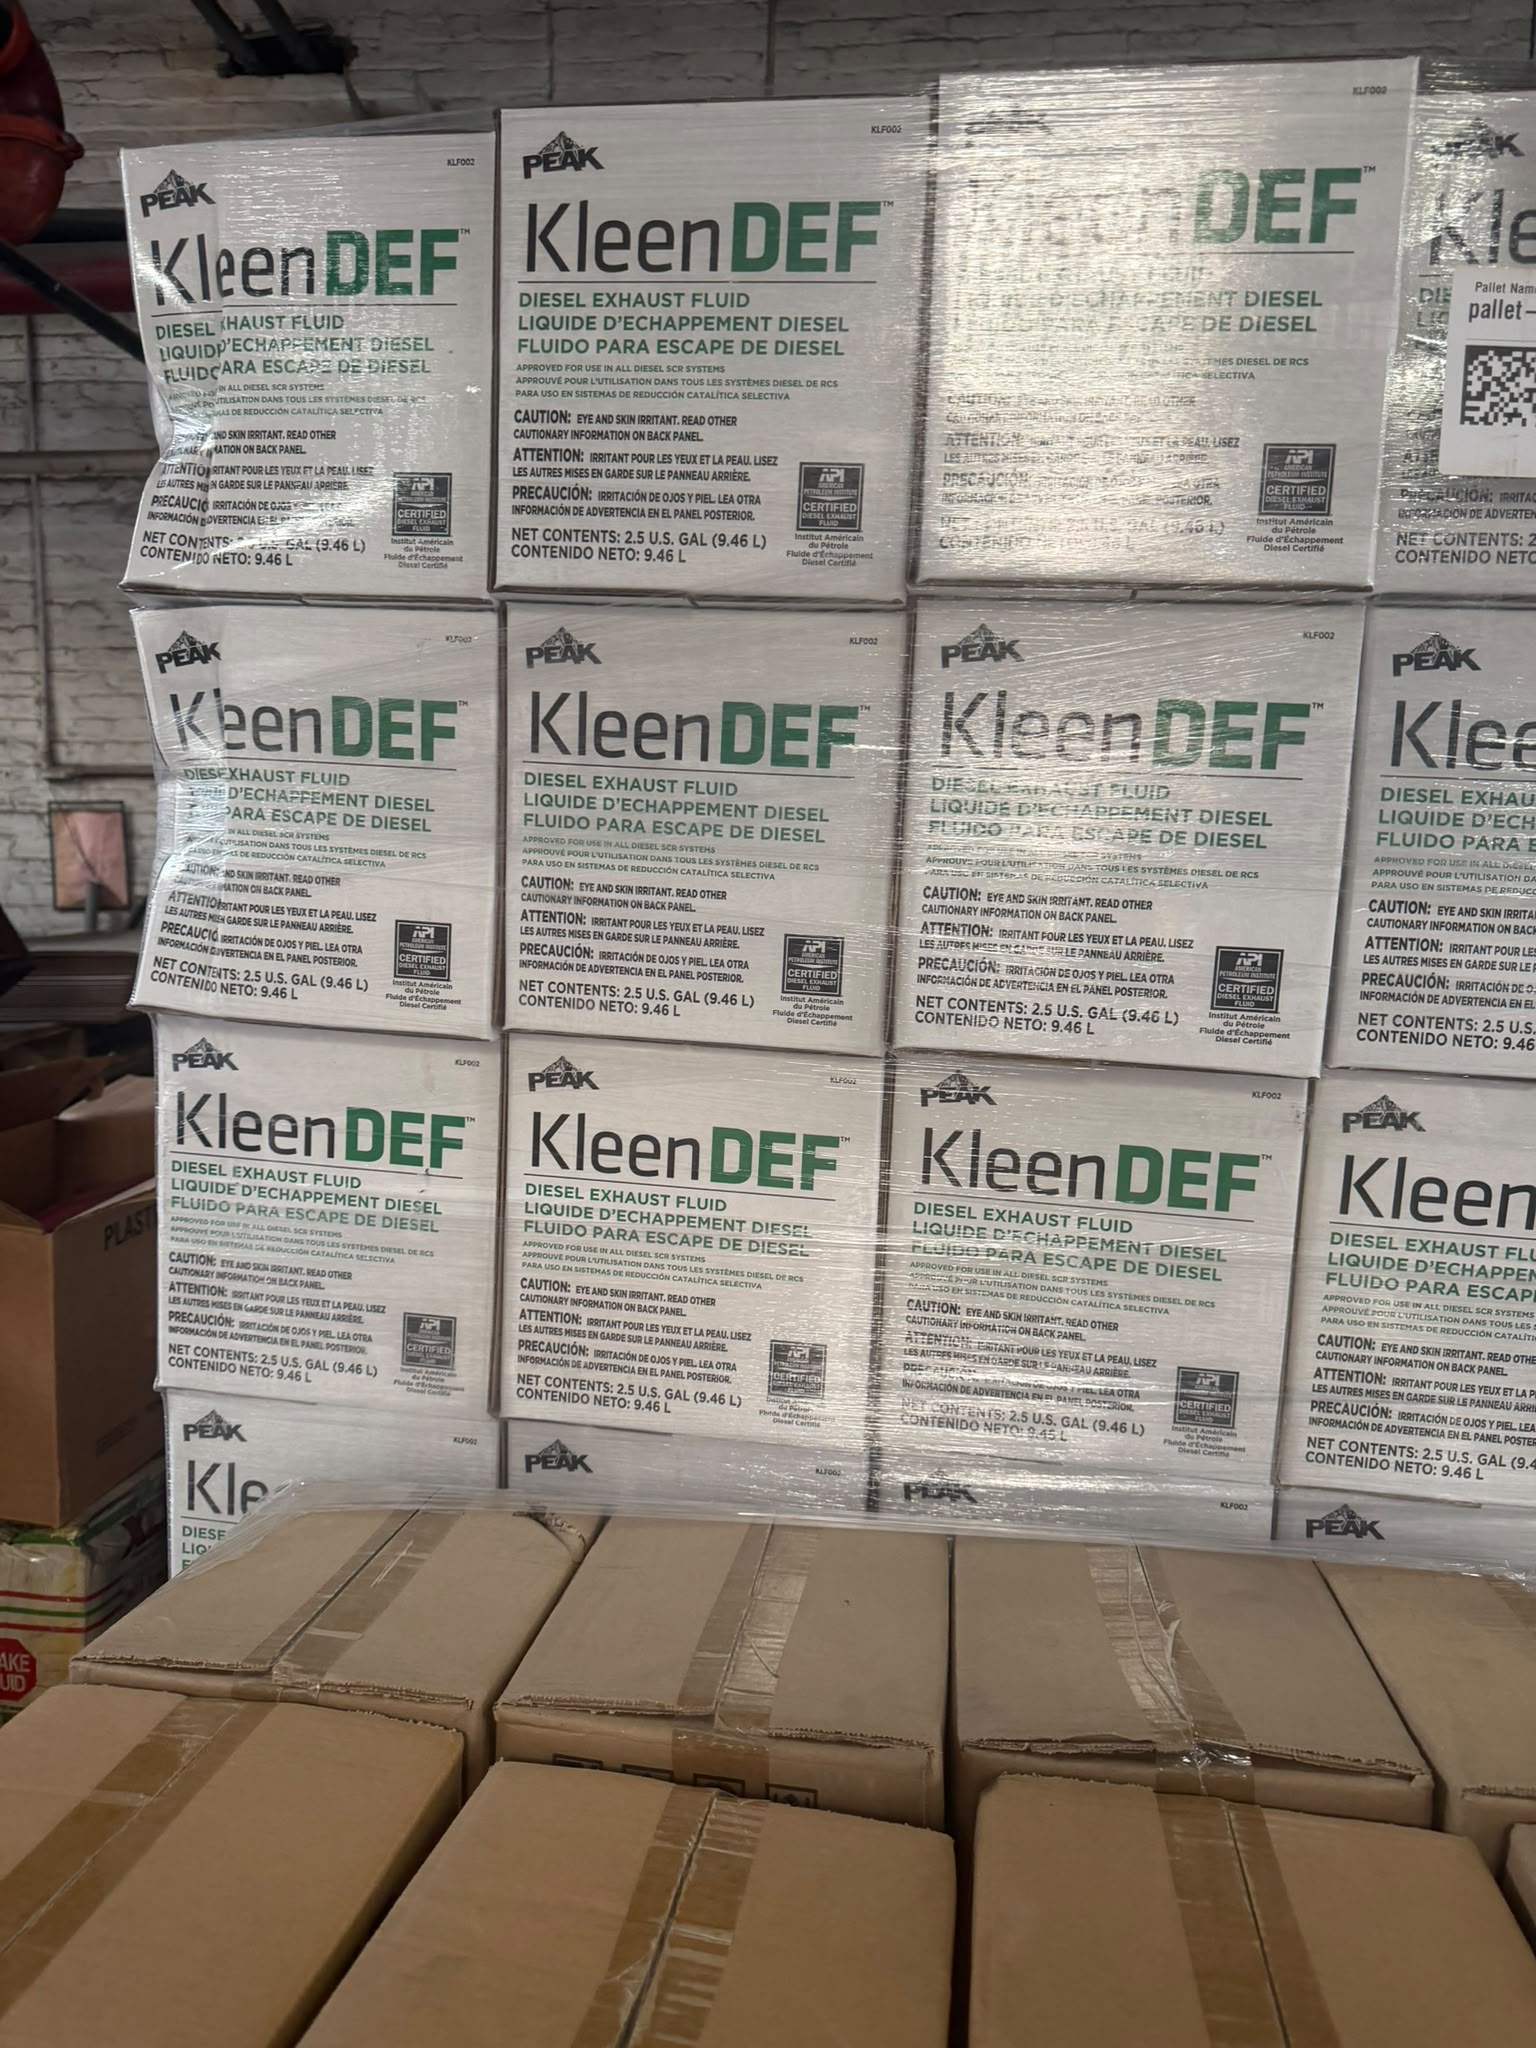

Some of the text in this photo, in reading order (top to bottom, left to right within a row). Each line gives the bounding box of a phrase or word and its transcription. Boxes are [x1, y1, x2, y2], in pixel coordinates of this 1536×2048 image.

[871, 125, 902, 134] KLF002
[447, 158, 475, 167] KLF002
[523, 147, 605, 179] PEAK
[140, 183, 216, 217] PEAK
[1475, 282, 1536, 294] Pallet Nam
[519, 292, 749, 307] DIESEL EXHAUST FLUID
[1246, 291, 1324, 307] DIESEL
[292, 315, 343, 330] FLUID
[518, 315, 849, 332] LIQUIDE D'ECHAPPEMENT DIESEL
[1240, 315, 1318, 331] DIESEL
[518, 338, 844, 355] FLUIDO PARA ESCAPE DE DIESEL
[516, 363, 563, 371] APPROVED
[564, 364, 583, 372] FOR
[585, 364, 601, 372] USE
[685, 365, 725, 373] SYSTEMS
[1237, 357, 1309, 365] DIESEL DE RCS
[516, 375, 562, 384] APPROUVÉ
[590, 377, 651, 385] L'UTILISATION
[706, 378, 722, 386] LES
[725, 378, 770, 386] SYSTÈMES
[772, 379, 803, 387] DIESEL
[514, 409, 737, 426] CAUTION: EYE AND SKIN IRRITANT. READ OTHER
[513, 428, 703, 441] CAUTIONARY INFORMATION ON BACK PANEL.
[819, 468, 844, 482] API
[1265, 485, 1326, 496] CERTIFIED
[802, 502, 857, 512] CERTIFIED
[512, 528, 766, 549] NET CONTENTS: 2.5 U.S. GAL (9.46 L)
[1433, 533, 1522, 546] CONTENTS:
[255, 553, 292, 567] 9.46 L
[511, 544, 686, 562] CONTENIDO NETO: 9.46 L
[1395, 549, 1491, 564] CONTENIDO
[1303, 631, 1335, 639] KLF002
[156, 640, 221, 673] PEAK
[526, 642, 602, 668] PEAK
[941, 640, 1025, 668] PEAK
[1392, 648, 1481, 676] PEAK
[375, 795, 435, 812] DIESEL
[1380, 786, 1455, 804] DIESEL
[922, 885, 981, 901] CAUTION:
[520, 909, 764, 936] ATTENTION: IRRITANT POUR LES YEUX ET LA PEAU. LISEZ
[244, 969, 367, 992] 2.5 U.S. GAL (9.46 L)
[1361, 969, 1450, 989] PRECAUCIÓN:
[1217, 983, 1274, 995] CERTIFIED
[172, 1052, 238, 1071] PEAK
[528, 1070, 600, 1091] PEAK
[921, 1085, 997, 1107] PEAK
[1252, 1091, 1281, 1099] KLF002
[1342, 1111, 1426, 1133] PEAK
[171, 1160, 360, 1189] DIESEL EXHAUST FLUID
[1339, 1154, 1536, 1231] Kleen
[1077, 1216, 1133, 1233] FLUID
[1327, 1252, 1408, 1271] LIQUIDE
[518, 1337, 737, 1371] PRECAUCIÓN: IRRITACIÓN DE OJOS Y PIEL. LEA OTRA
[183, 1424, 247, 1442] PEAK
[524, 1454, 593, 1473] PEAK
[1305, 1451, 1483, 1480] CONTENIDO NETO: 9.46 L
[1220, 1501, 1248, 1510] KLF002
[182, 1526, 226, 1541] DIESE
[1306, 1518, 1385, 1540] PEAK
